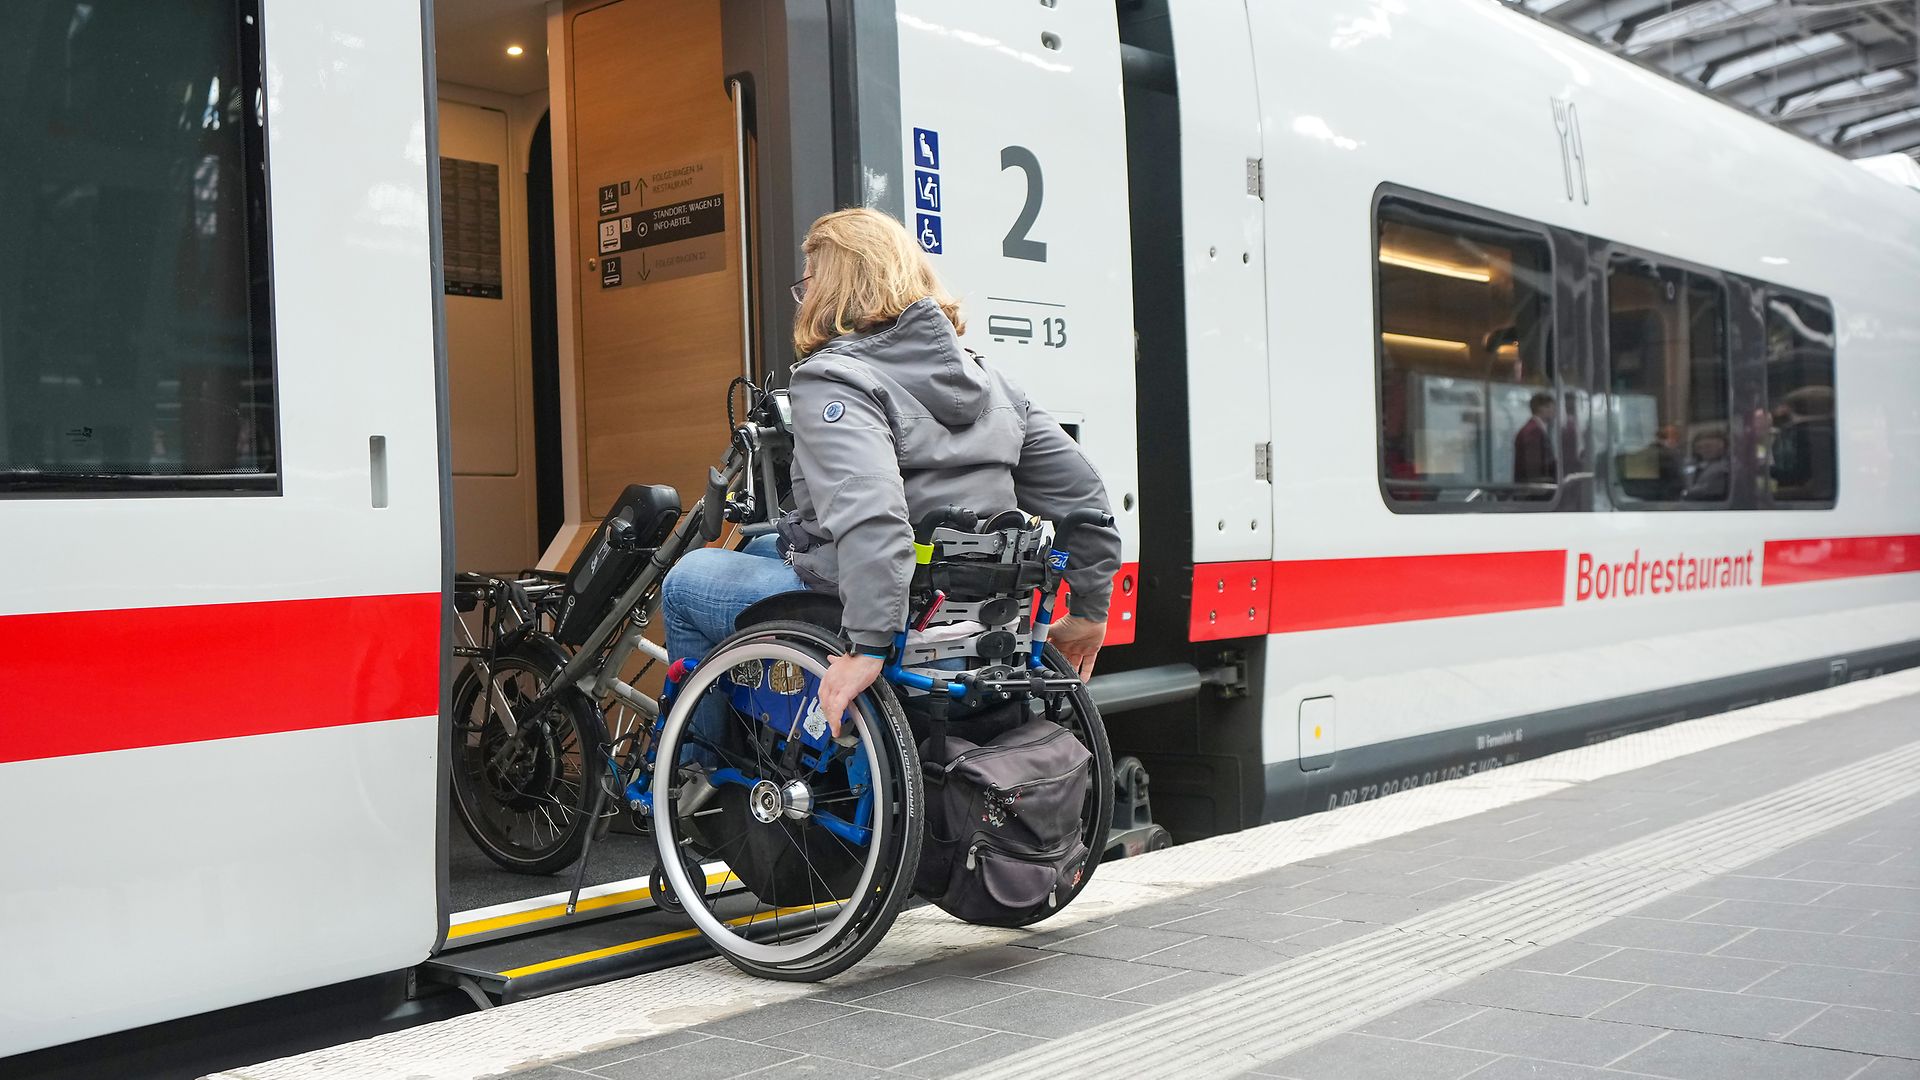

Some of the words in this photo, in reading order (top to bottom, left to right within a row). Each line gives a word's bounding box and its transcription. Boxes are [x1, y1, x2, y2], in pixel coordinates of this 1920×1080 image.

[652, 165, 695, 182] FOLGEWAGEN
[604, 188, 614, 201] 14
[653, 177, 693, 193] RESTAURANT
[653, 203, 688, 220] STANDORT:
[688, 199, 713, 213] WAGEN
[713, 197, 722, 208] 13
[1000, 145, 1047, 263] 2
[606, 225, 615, 237] 13
[653, 216, 692, 231] INFO-ABTEIL
[607, 261, 616, 273] 12
[1042, 316, 1067, 349] 13
[1577, 549, 1754, 601] Bordrestaurant
[891, 715, 906, 748] PLUS
[902, 749, 915, 818] MARATHON
